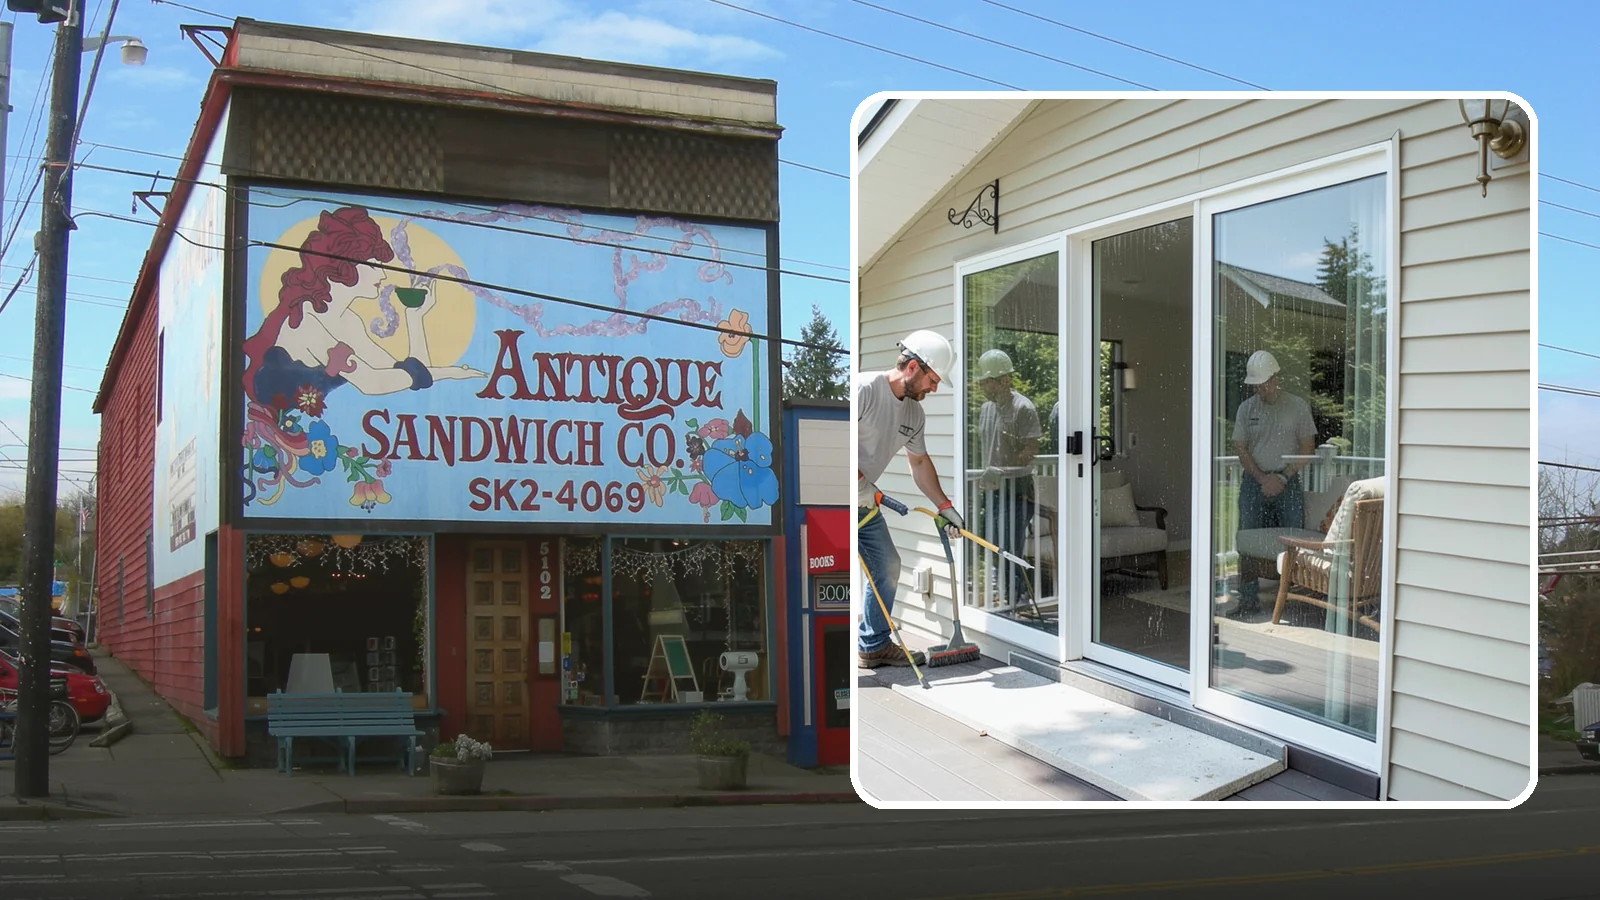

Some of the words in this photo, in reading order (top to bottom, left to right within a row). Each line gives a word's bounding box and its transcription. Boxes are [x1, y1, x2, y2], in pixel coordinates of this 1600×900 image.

[475, 328, 724, 421] ANTIQUE
[361, 408, 604, 467] SANDWICH
[617, 421, 685, 469] CO.
[468, 477, 646, 513] SK2-4069
[539, 541, 552, 599] 5102
[809, 554, 835, 569] BOOKS
